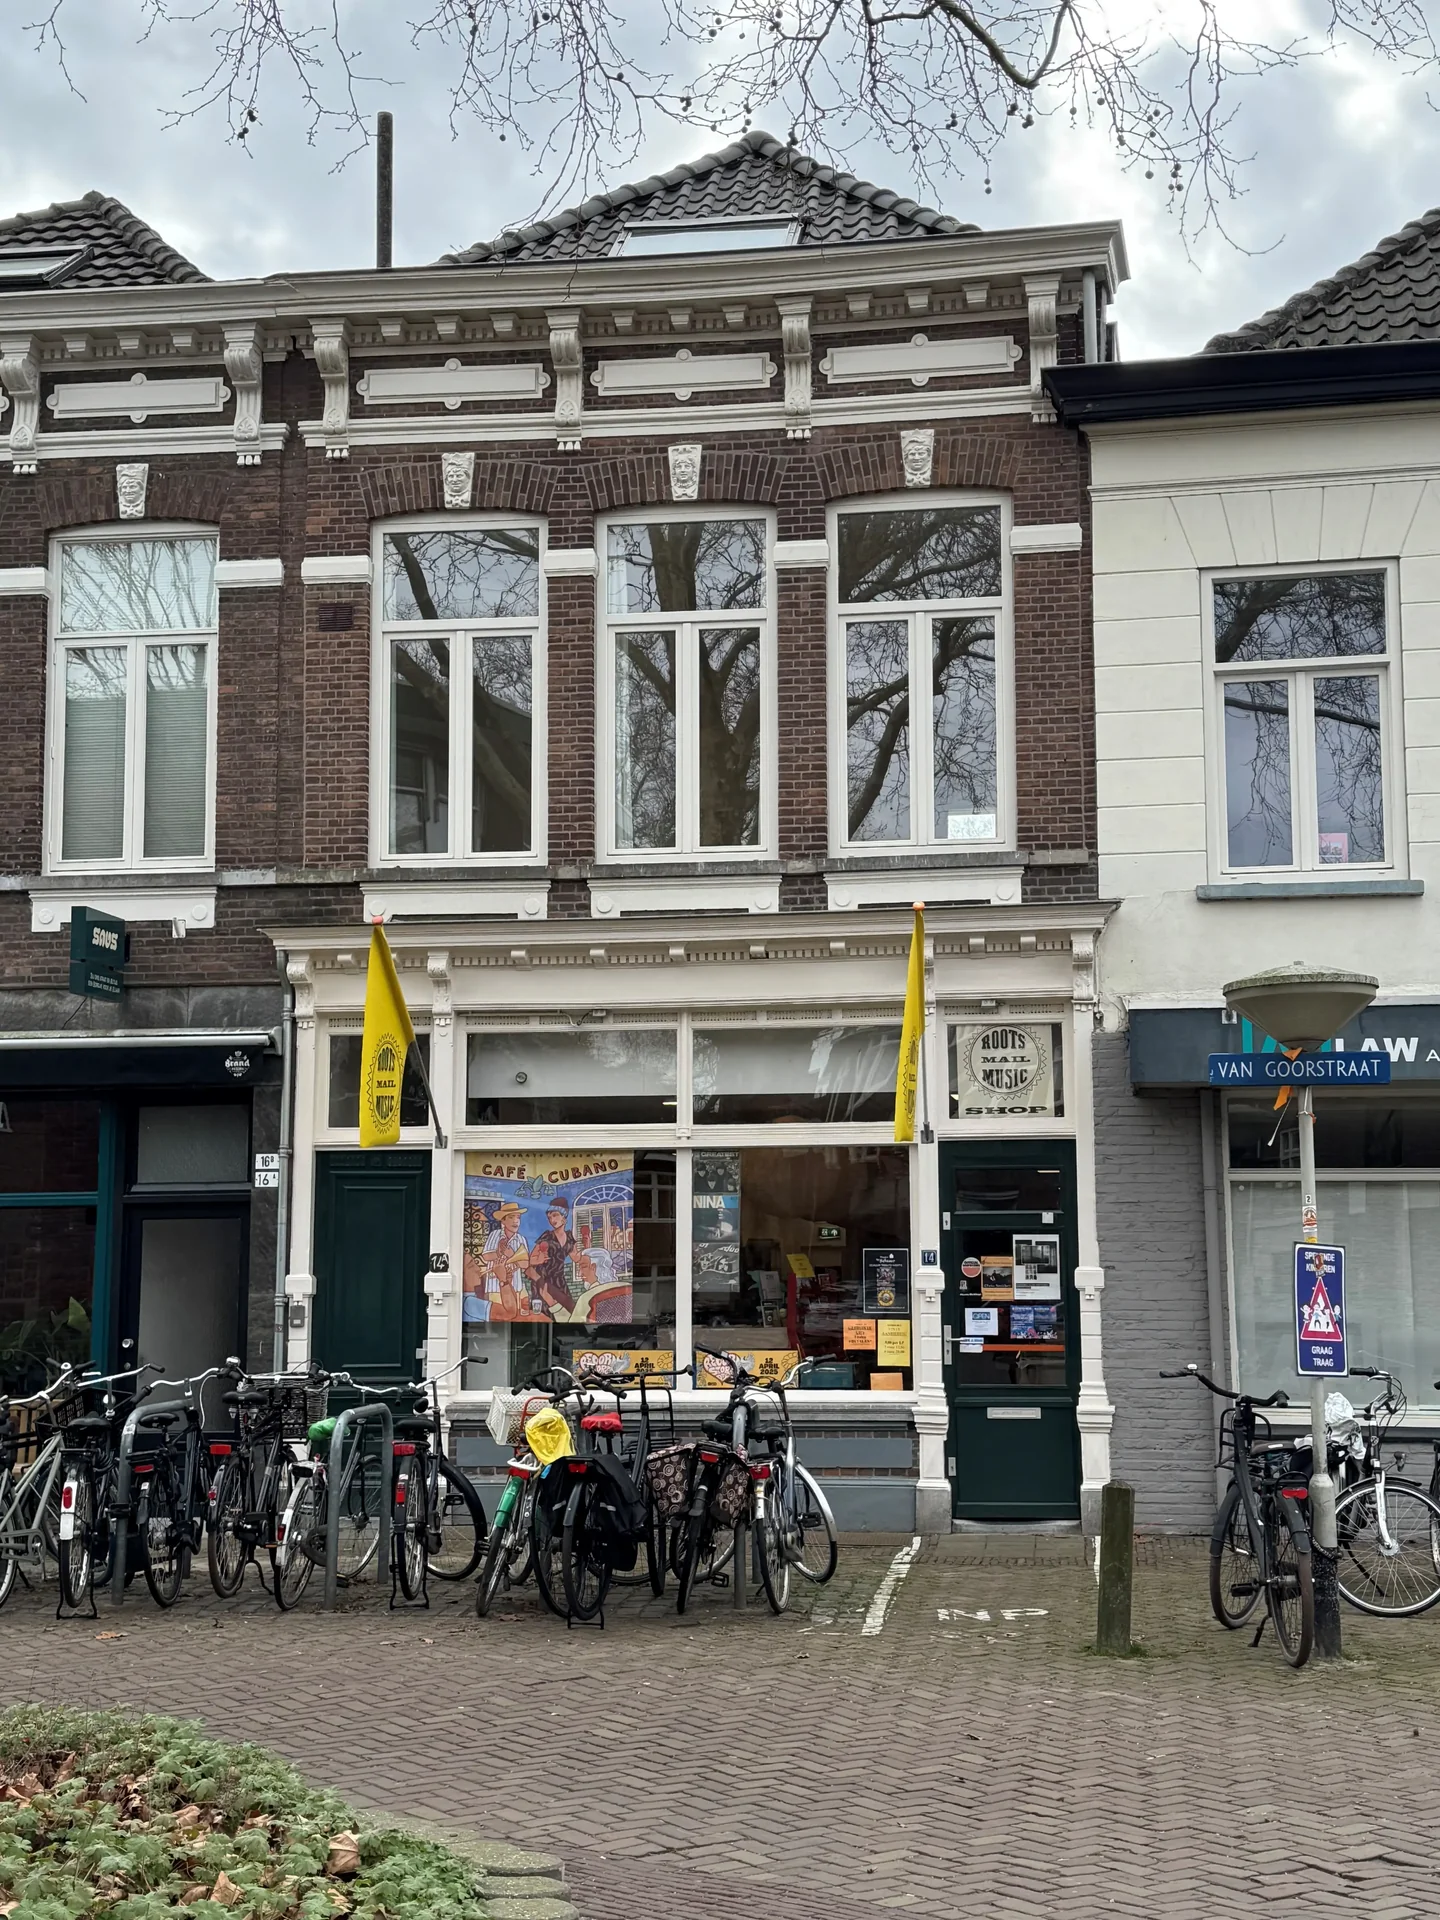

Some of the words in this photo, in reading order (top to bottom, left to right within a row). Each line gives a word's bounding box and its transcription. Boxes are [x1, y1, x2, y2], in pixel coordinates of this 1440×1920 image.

[92, 926, 119, 951] SAUS
[981, 1028, 1026, 1050] ROOTS
[224, 1058, 250, 1068] Brand
[981, 1055, 1031, 1064] MAIL
[1217, 1061, 1252, 1078] VAN
[1264, 1059, 1381, 1078] GOORSTRAAT
[376, 1079, 396, 1089] MAIL
[982, 1068, 1028, 1090] MUSIC
[964, 1105, 1048, 1115] SHOP
[481, 1163, 527, 1180] CAFÉ
[547, 1158, 620, 1184] CUBANO
[693, 1195, 726, 1209] NINA
[1306, 1195, 1311, 1203] 2
[431, 1254, 449, 1270] 14A
[924, 1252, 934, 1263] 14
[1304, 1251, 1335, 1262] SPENDE
[1305, 1263, 1336, 1274] KINREN
[972, 1311, 991, 1321] OPEN
[1311, 1345, 1333, 1355] GRAAG
[1312, 1357, 1334, 1368] TRAAG
